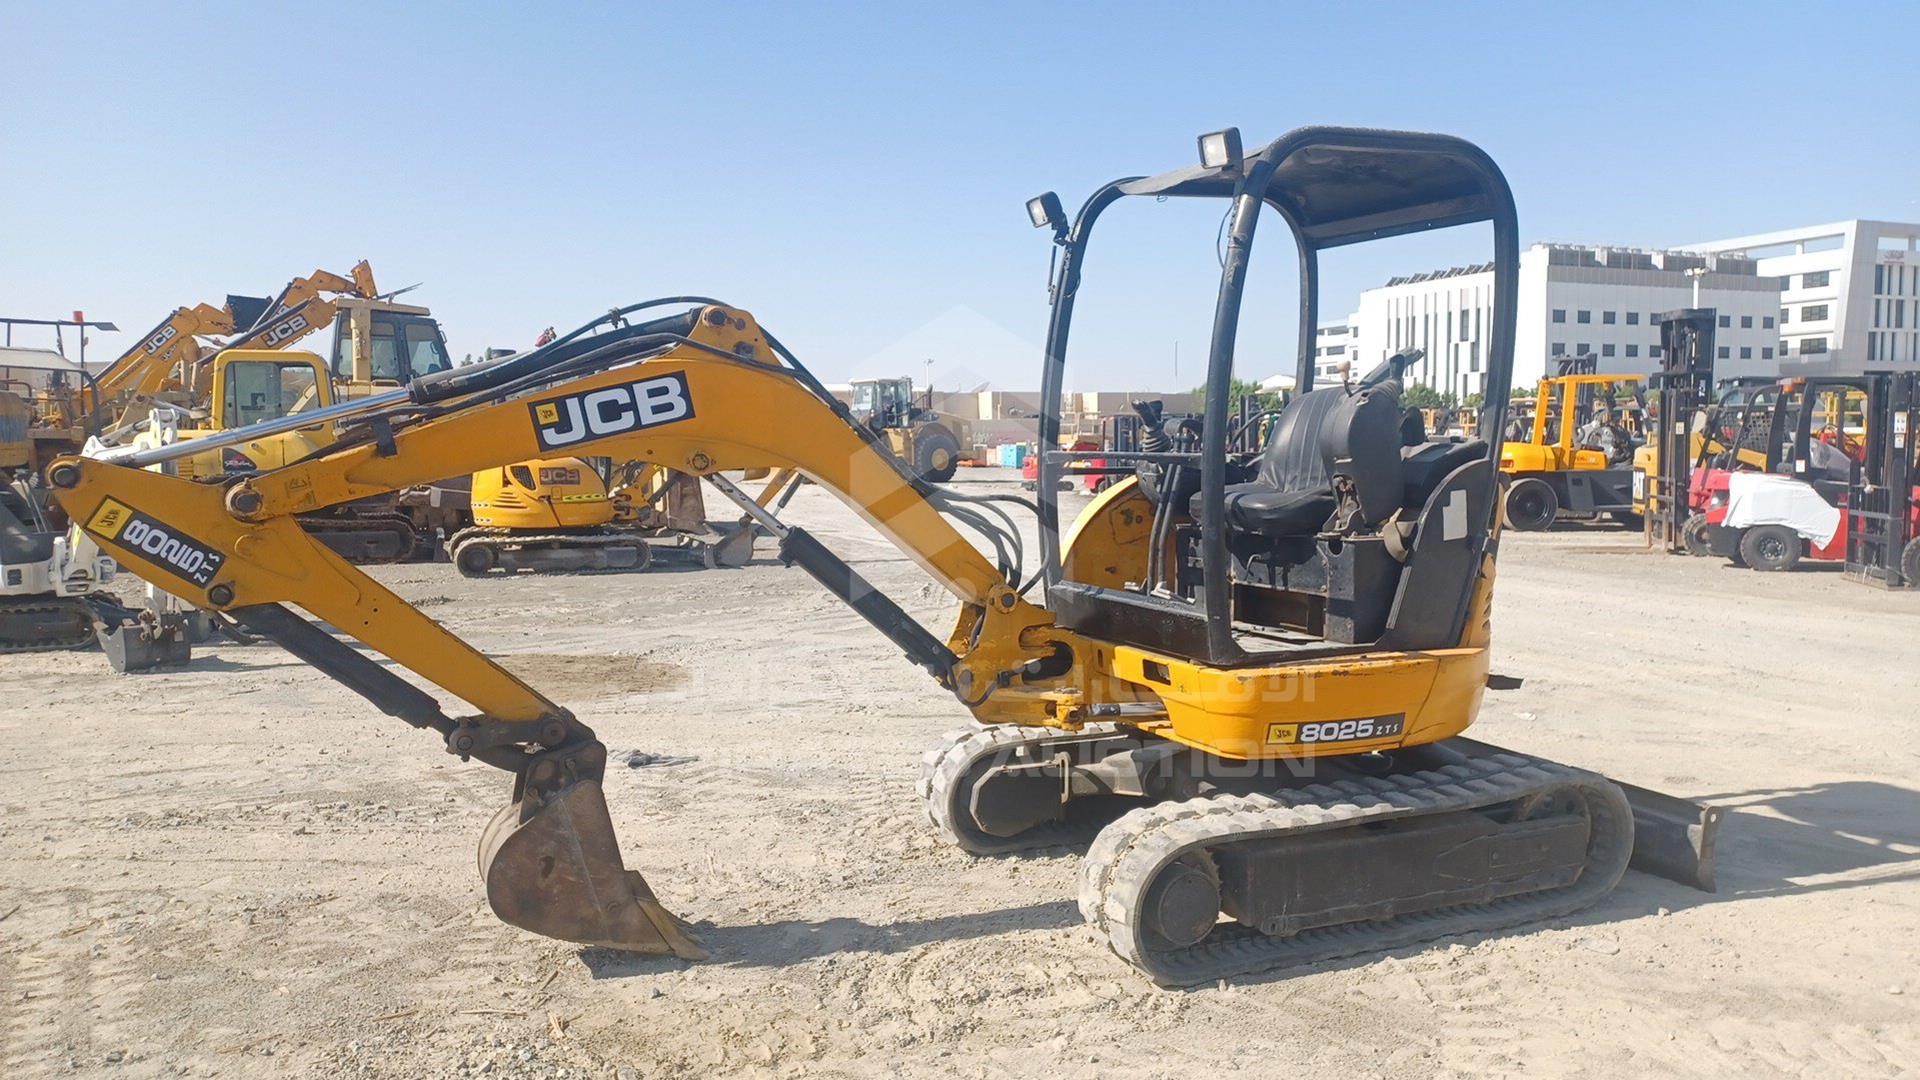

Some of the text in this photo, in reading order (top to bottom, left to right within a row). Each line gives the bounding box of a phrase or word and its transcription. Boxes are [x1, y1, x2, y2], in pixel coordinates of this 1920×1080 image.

[147, 326, 177, 354] JCB
[267, 315, 307, 346] JCB
[542, 376, 687, 446] JCB
[541, 468, 579, 482] JCB
[123, 519, 220, 584] 8025 ZTS
[1300, 719, 1400, 742] 8025 ZTS
